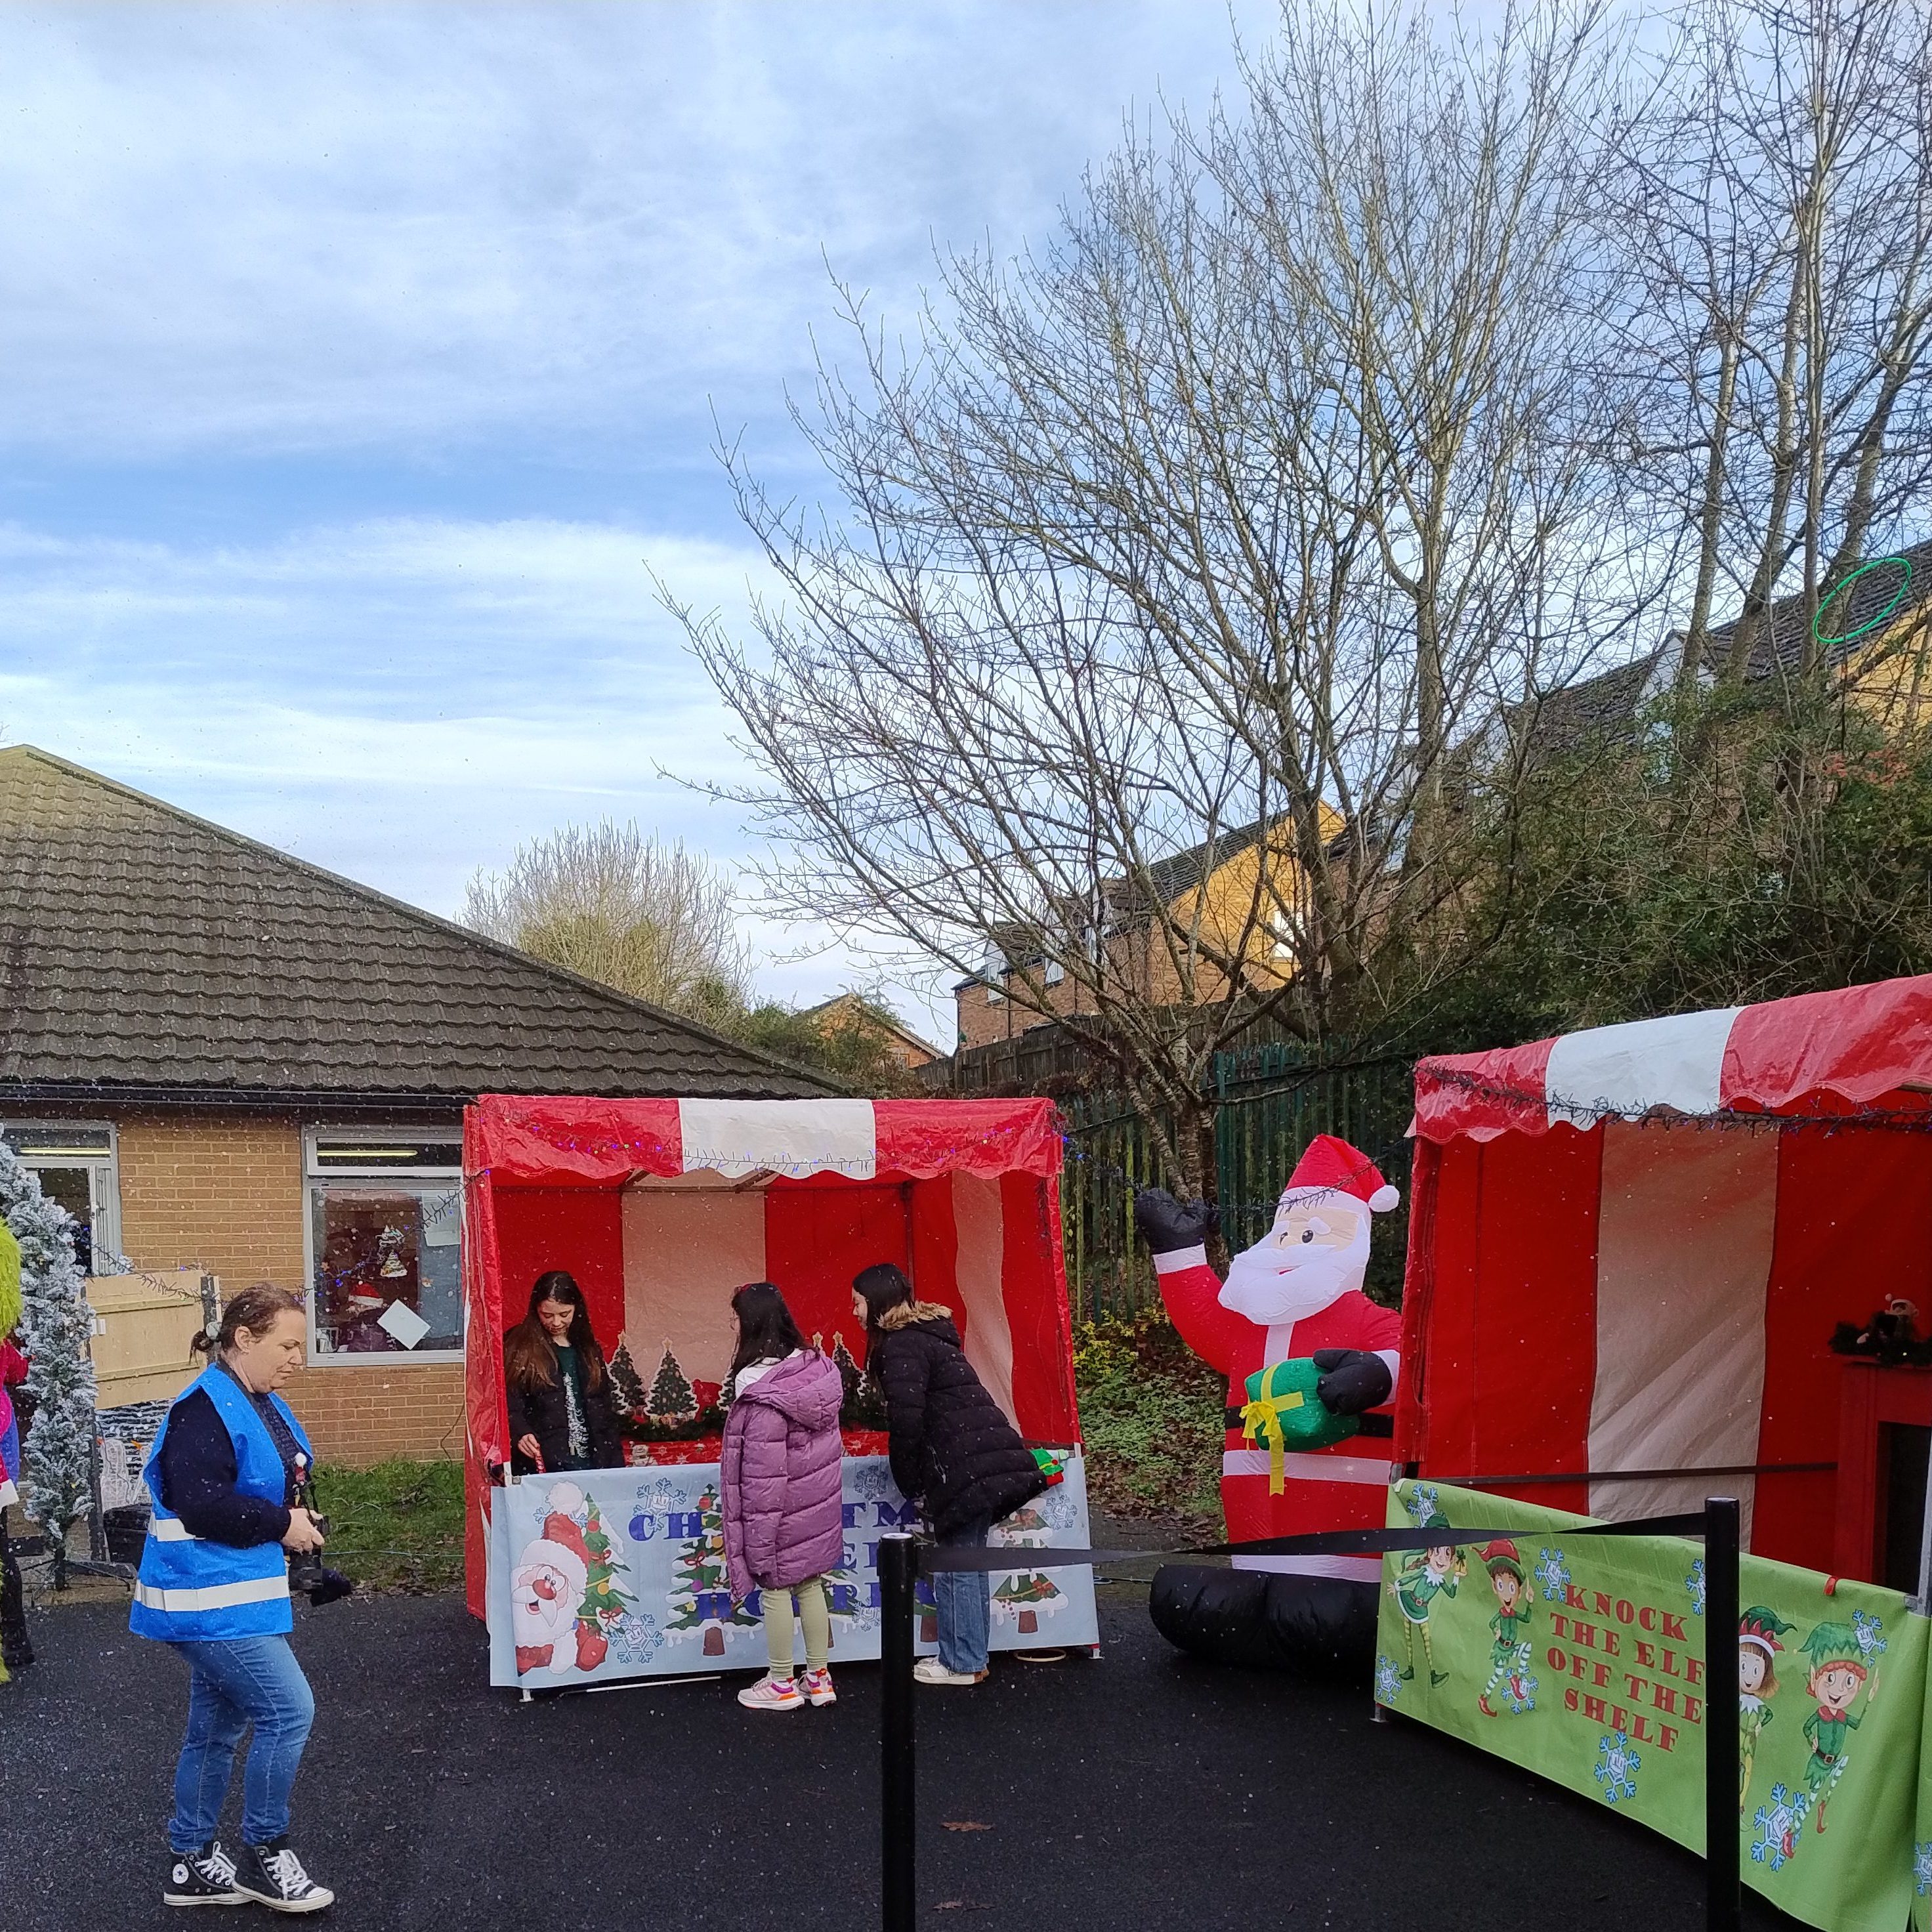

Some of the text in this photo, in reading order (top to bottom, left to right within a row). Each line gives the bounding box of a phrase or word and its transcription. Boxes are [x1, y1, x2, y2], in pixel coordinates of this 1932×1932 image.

[1564, 1583, 1688, 1642] KNOCK
[1549, 1612, 1705, 1685] THE ELF
[1547, 1647, 1702, 1725] OFF THE
[1564, 1687, 1679, 1753] SHELF
